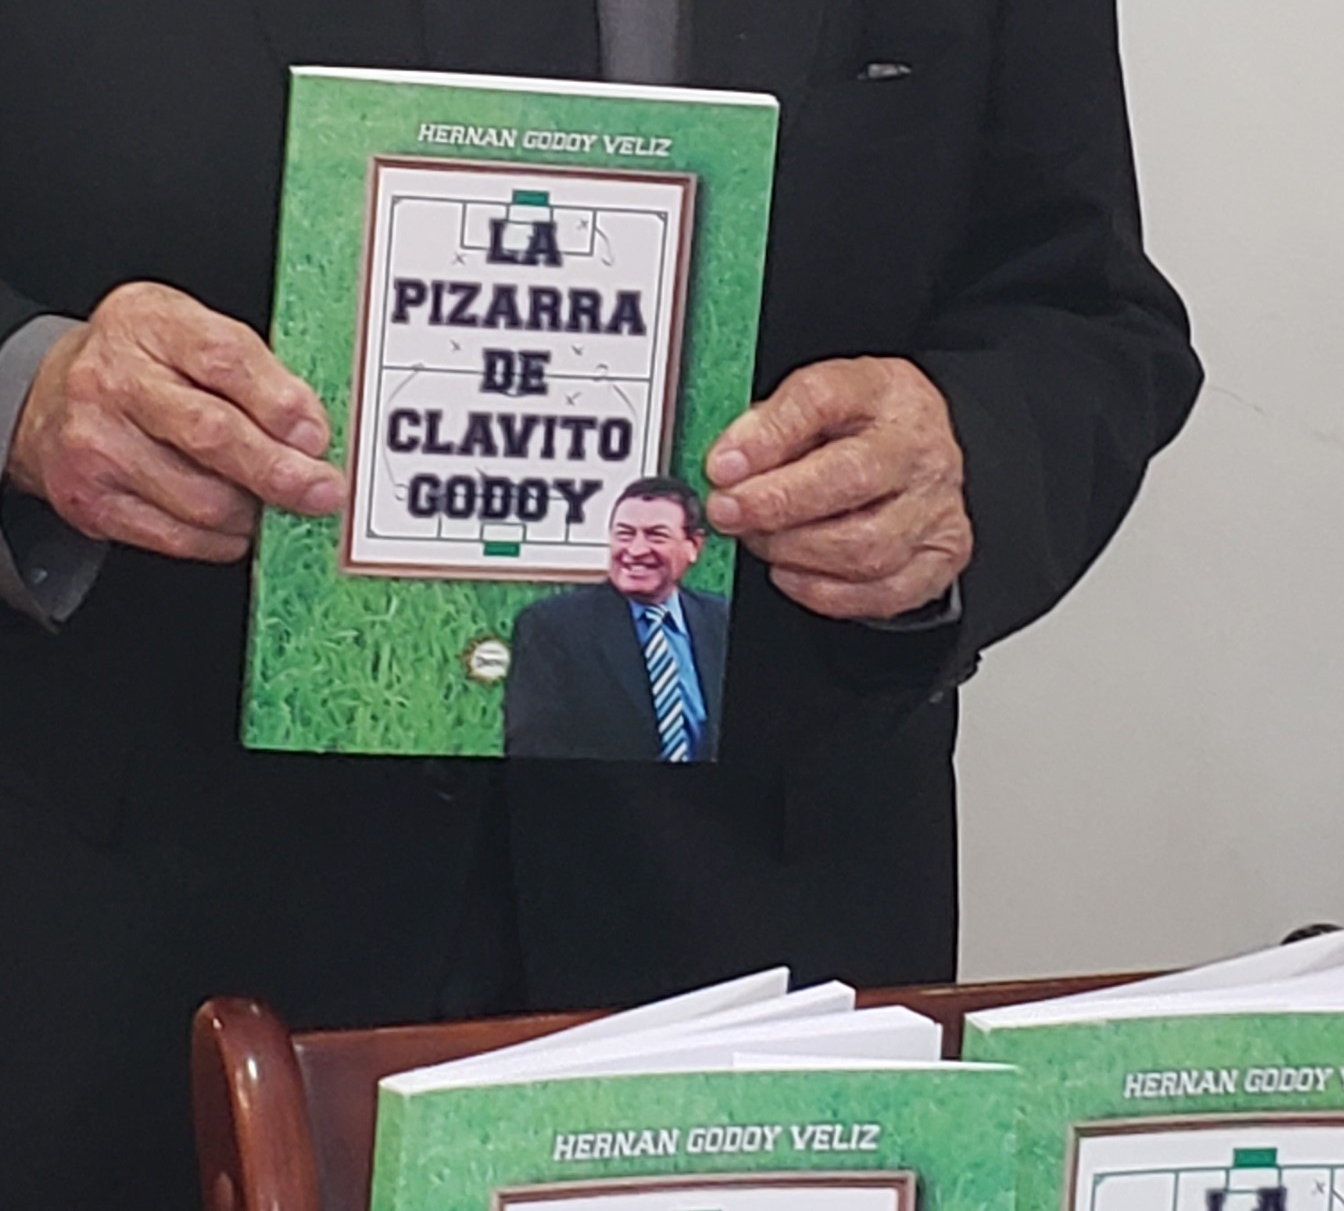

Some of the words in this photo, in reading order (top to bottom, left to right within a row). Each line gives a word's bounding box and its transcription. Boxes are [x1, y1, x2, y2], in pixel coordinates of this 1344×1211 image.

[417, 122, 518, 150] HERNAN
[522, 129, 597, 155] GODOY
[602, 134, 674, 158] VELIZ
[485, 218, 563, 268] LA
[390, 277, 647, 337] PIZARRA
[478, 347, 552, 396] DE
[385, 407, 633, 462] CLAVITO
[407, 472, 604, 525] GODOY
[1123, 1068, 1236, 1099] HERNAN
[1244, 1066, 1334, 1094] GODOY
[553, 1127, 681, 1162] HERNAN
[686, 1124, 783, 1155] GODOY
[789, 1123, 882, 1151] VELIZ
